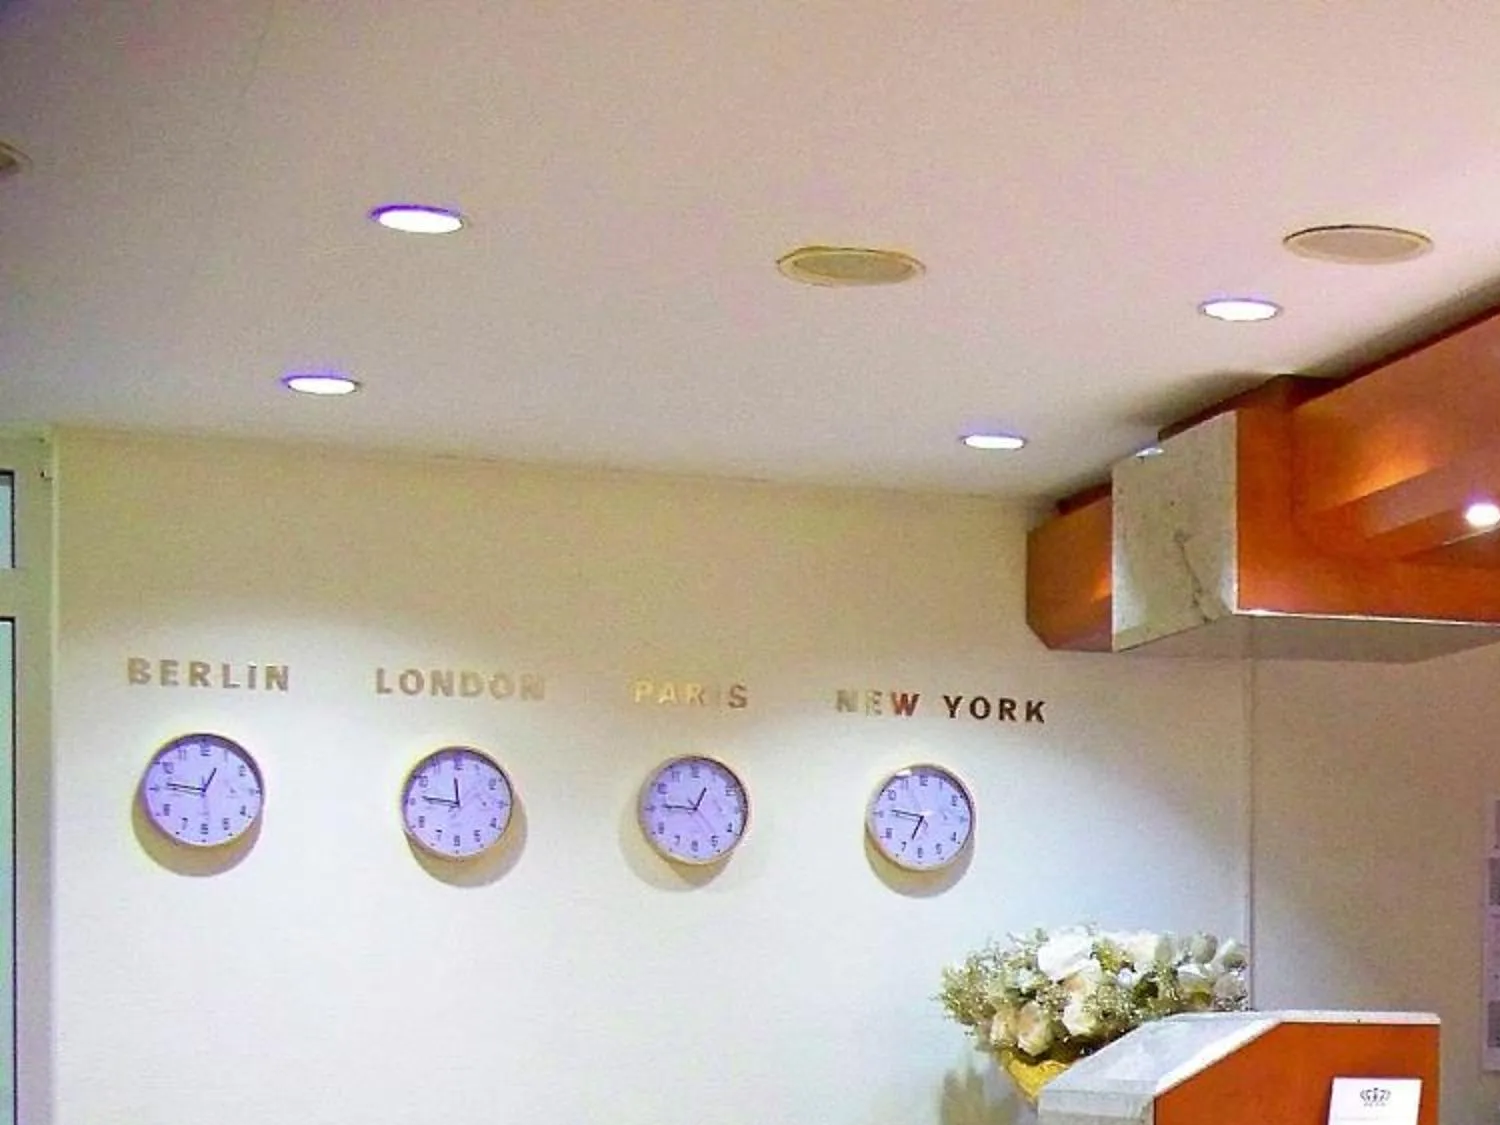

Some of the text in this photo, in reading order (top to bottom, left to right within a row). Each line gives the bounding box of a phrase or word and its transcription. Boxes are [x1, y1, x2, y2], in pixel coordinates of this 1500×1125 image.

[127, 657, 290, 692] BERLIN
[375, 667, 546, 700] LONDON
[836, 688, 1047, 723] NEW YORK
